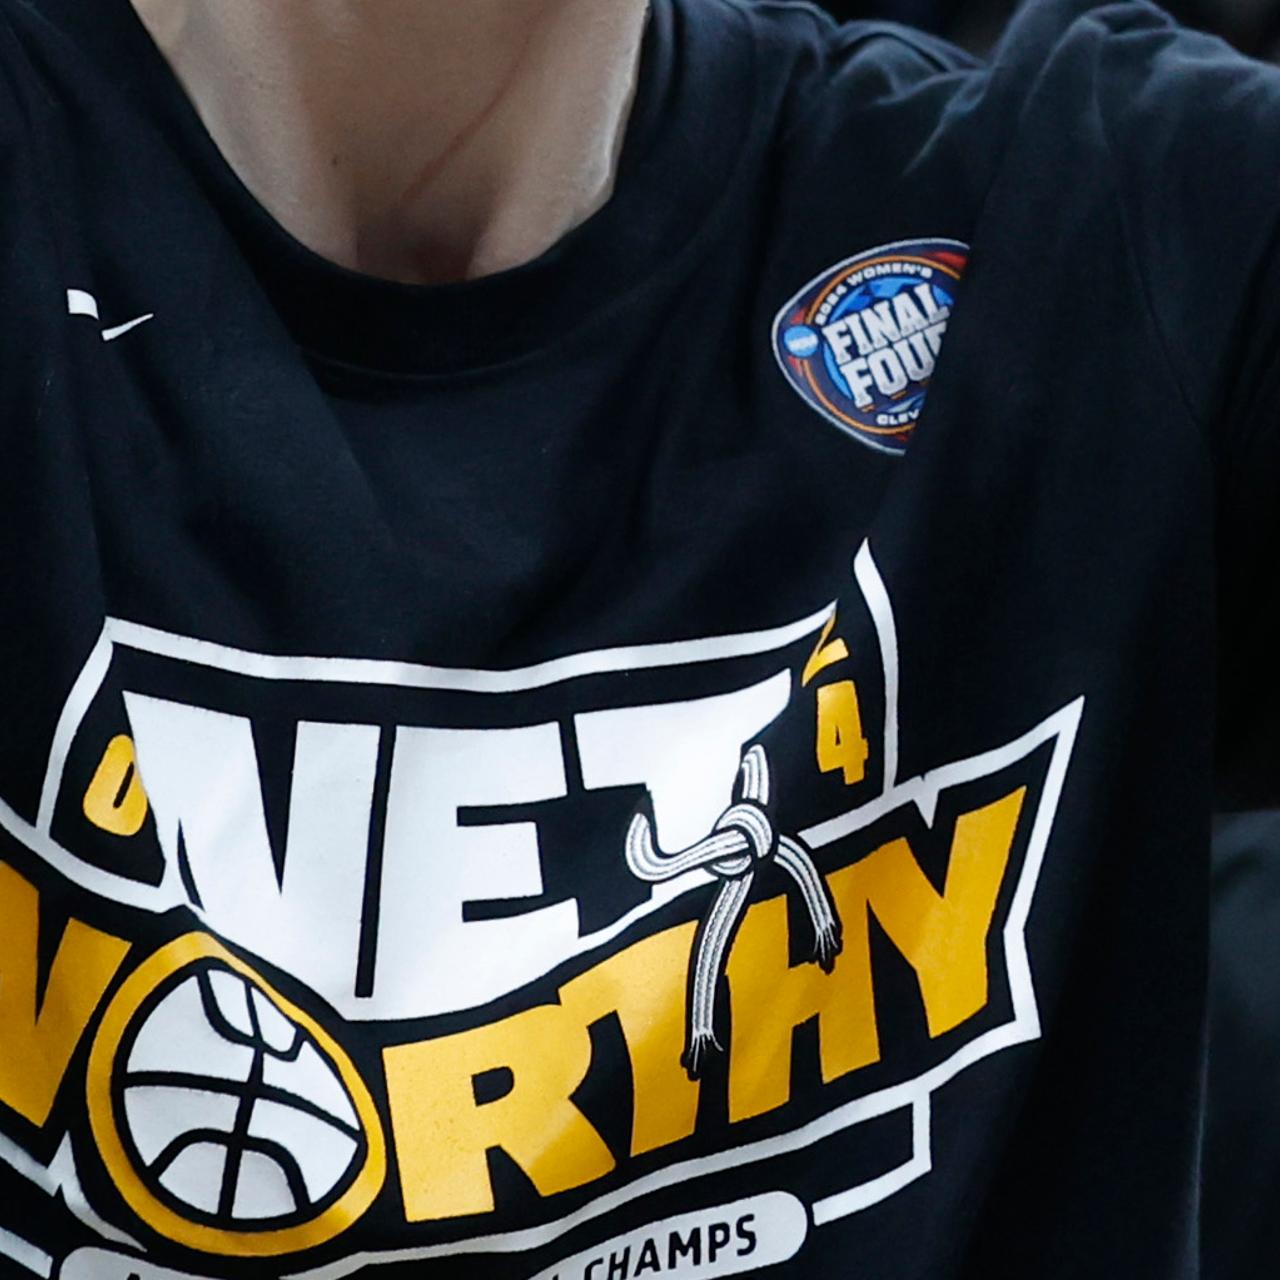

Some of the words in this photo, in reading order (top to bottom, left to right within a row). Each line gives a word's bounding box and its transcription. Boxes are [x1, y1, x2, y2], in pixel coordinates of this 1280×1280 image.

[821, 281, 951, 364] FINAL
[122, 668, 792, 1022] NET
[584, 1213, 757, 1280] CHAMPS
